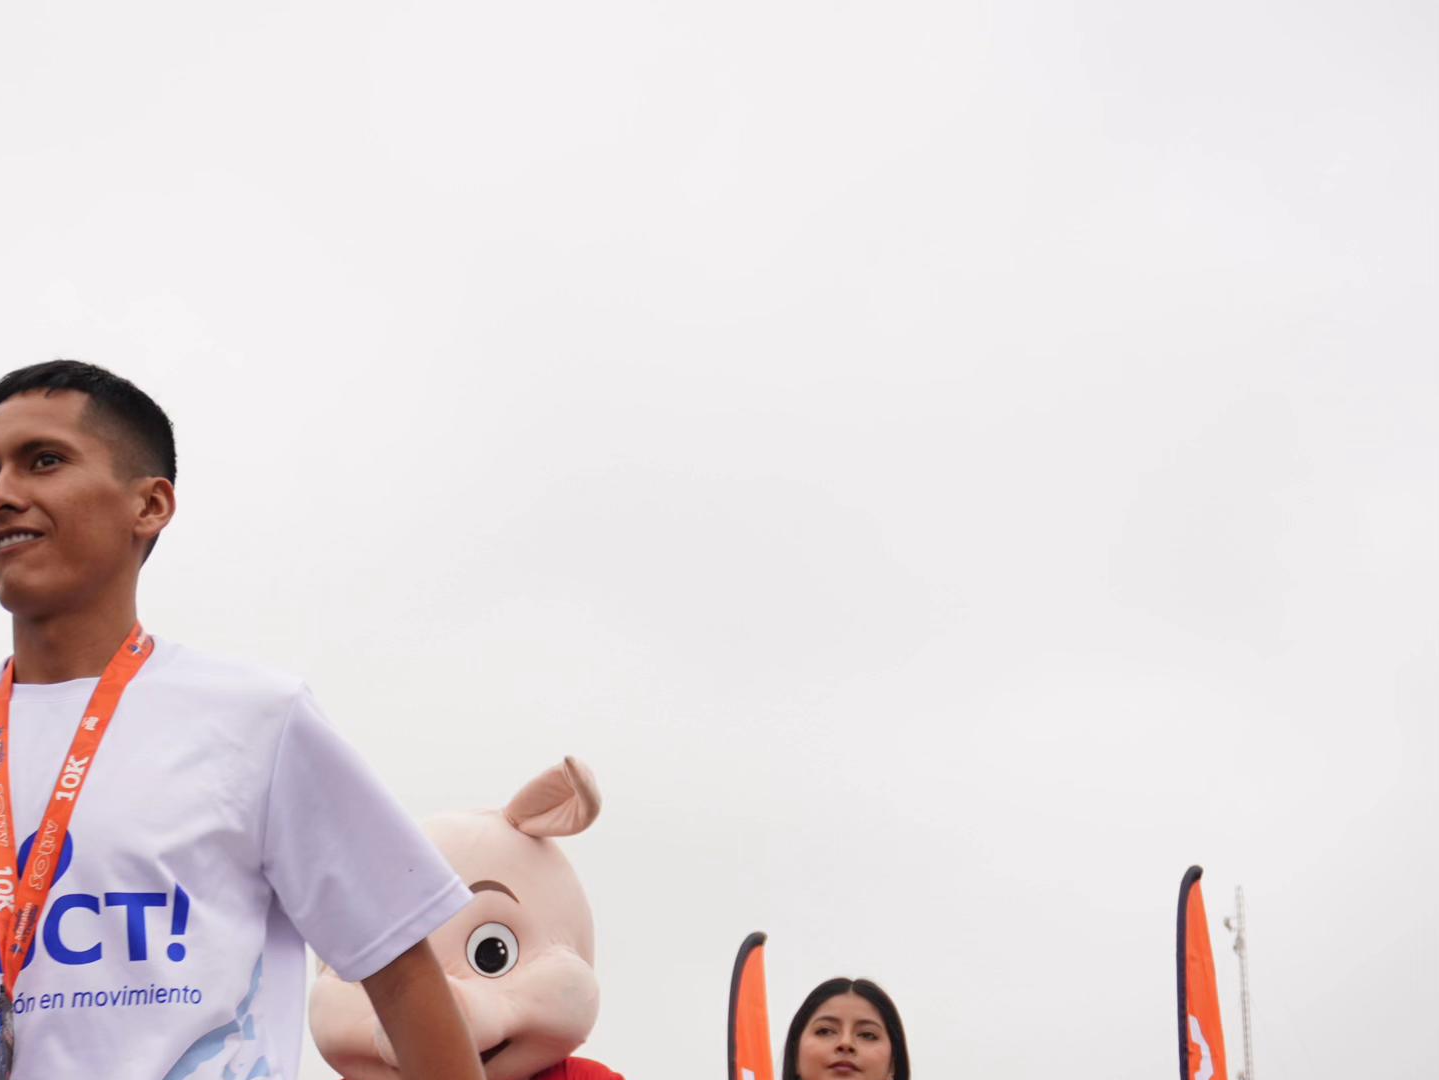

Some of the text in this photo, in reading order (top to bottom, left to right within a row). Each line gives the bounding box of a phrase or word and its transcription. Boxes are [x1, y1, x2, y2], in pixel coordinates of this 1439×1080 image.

[56, 755, 91, 802] 10K
[39, 991, 64, 1010] en
[71, 983, 203, 1009] movimiento
